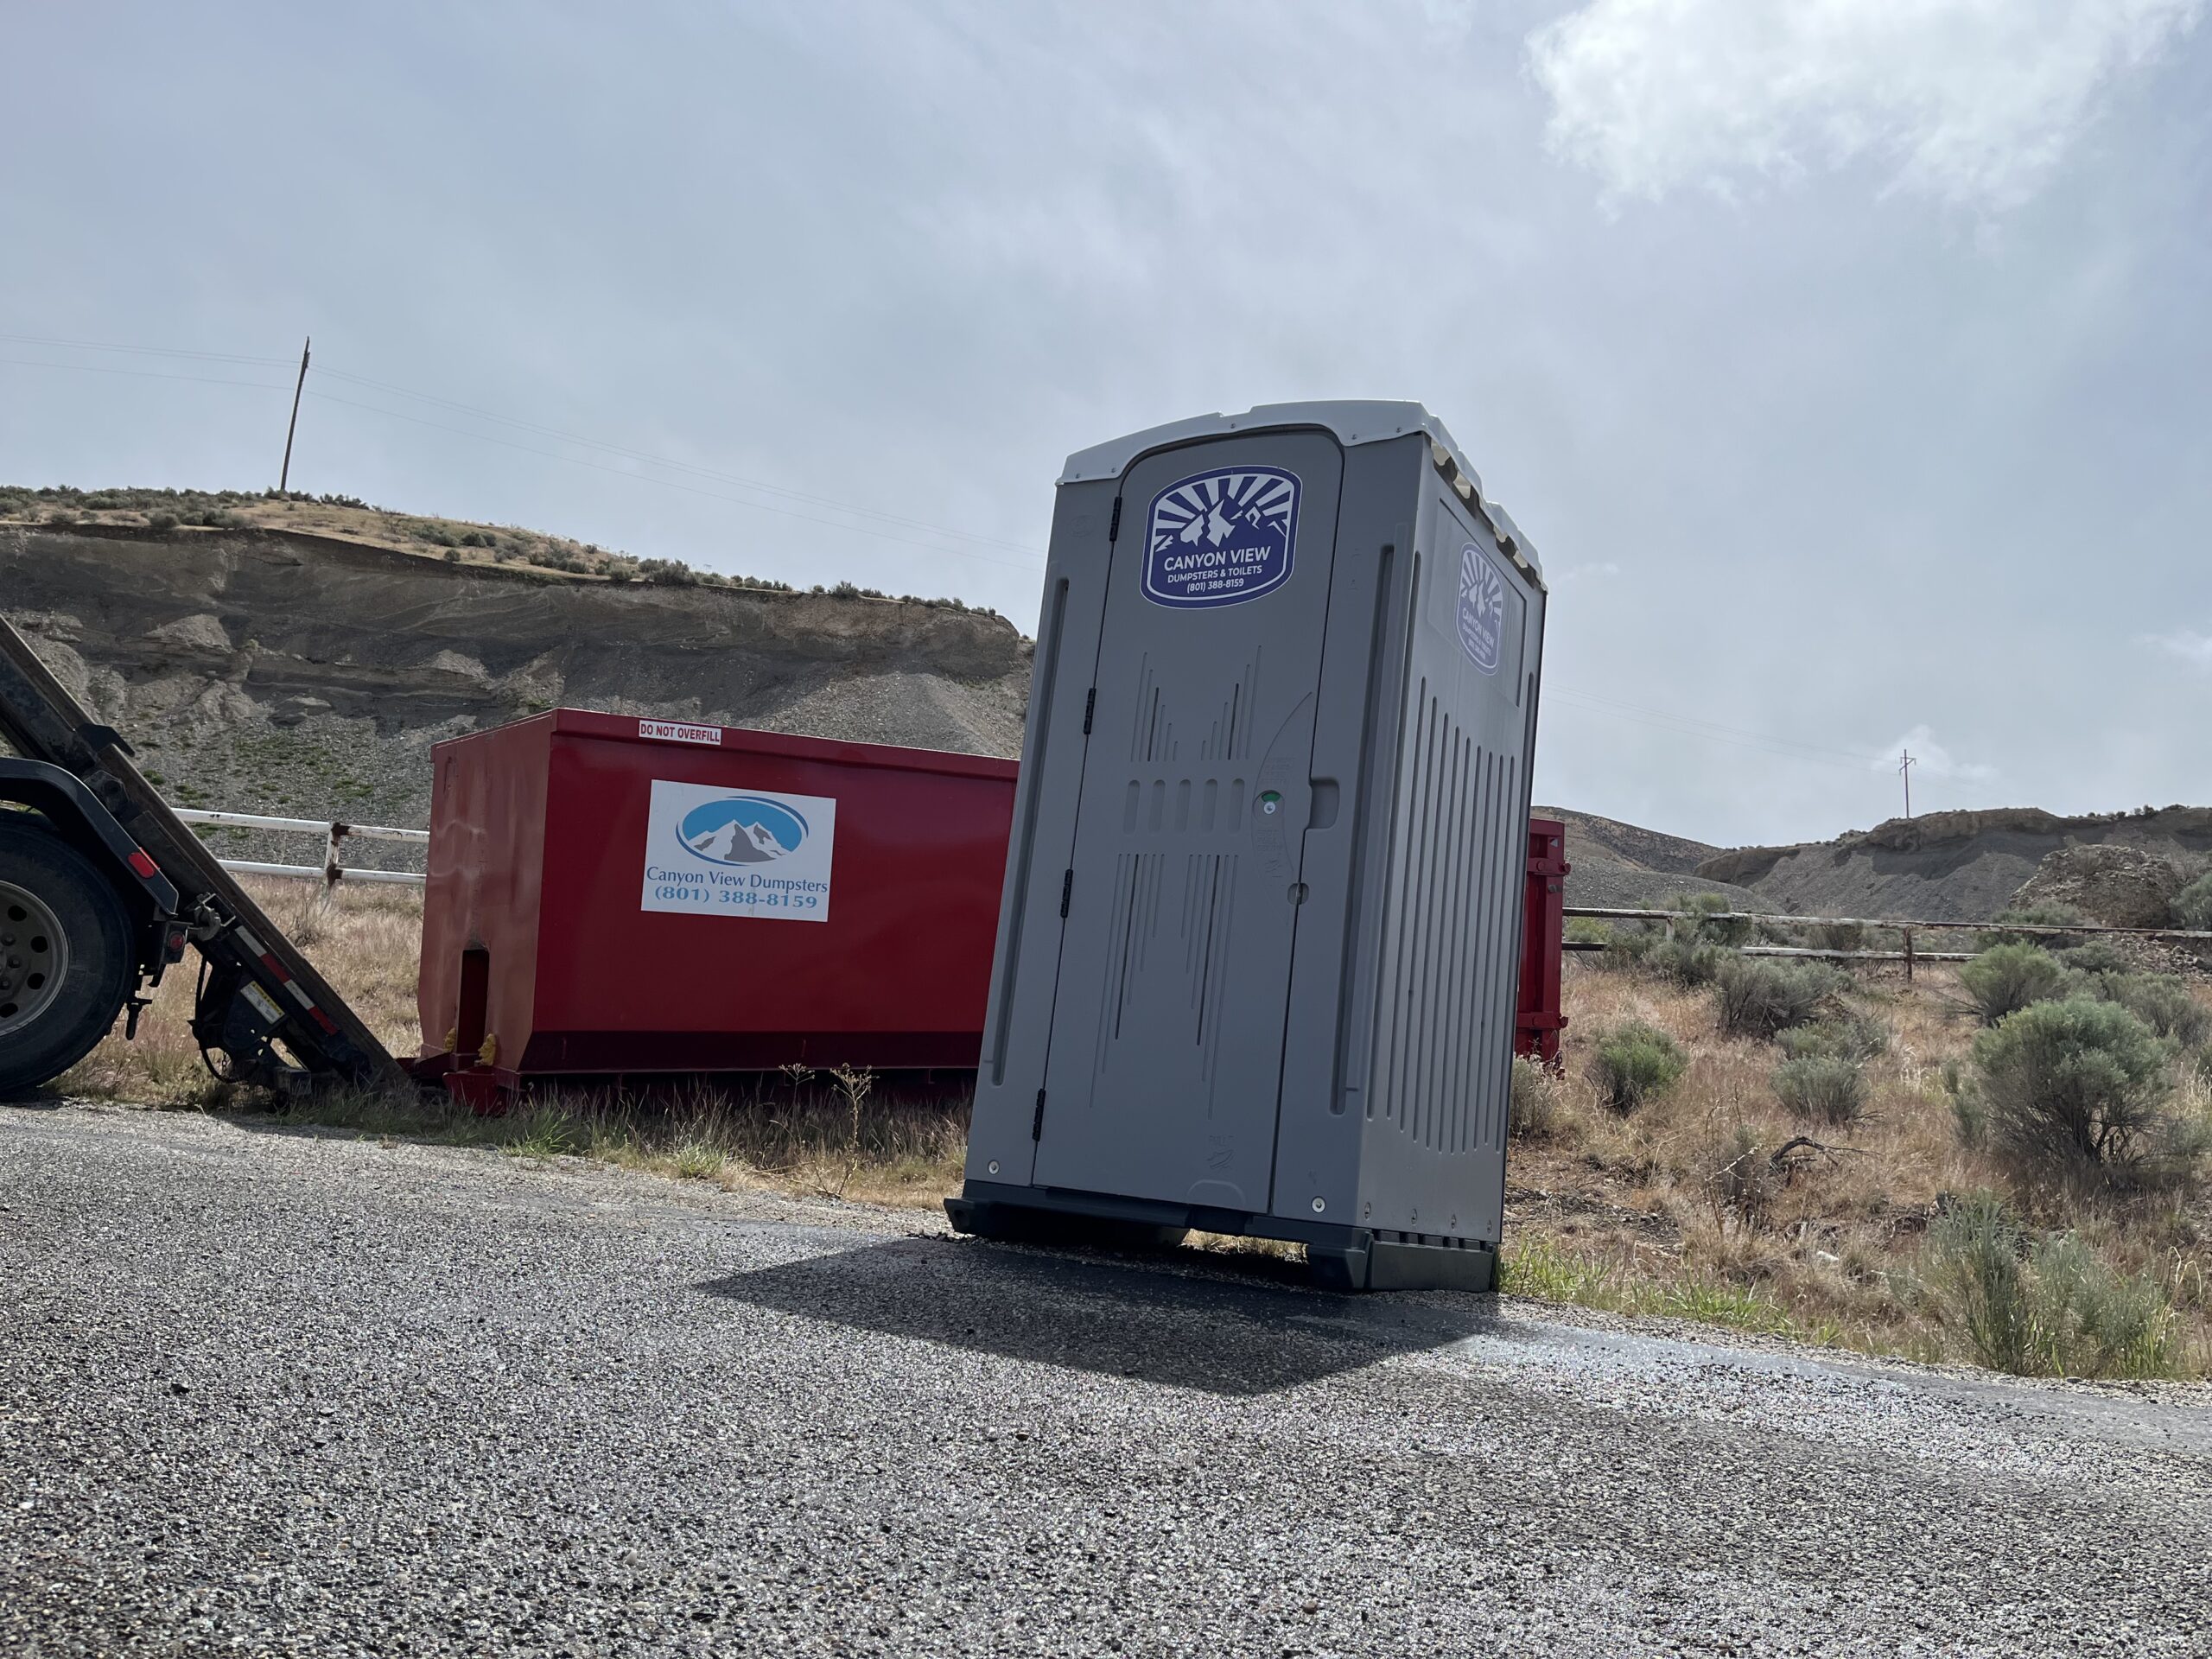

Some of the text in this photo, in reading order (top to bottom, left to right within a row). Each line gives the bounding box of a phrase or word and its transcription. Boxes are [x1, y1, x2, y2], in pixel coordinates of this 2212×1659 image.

[1164, 546, 1271, 571] CANYON VIEW
[1167, 565, 1262, 583] DUMPSTERS & TOILETS
[1186, 578, 1244, 594] (801) 388-8159
[1462, 607, 1483, 636] CANYON
[1482, 626, 1495, 648] VIEW
[640, 723, 720, 742] DO NOT OVERFILL
[646, 866, 828, 893] Canyon View Dumpsters
[655, 885, 817, 908] (801) 388-8159
